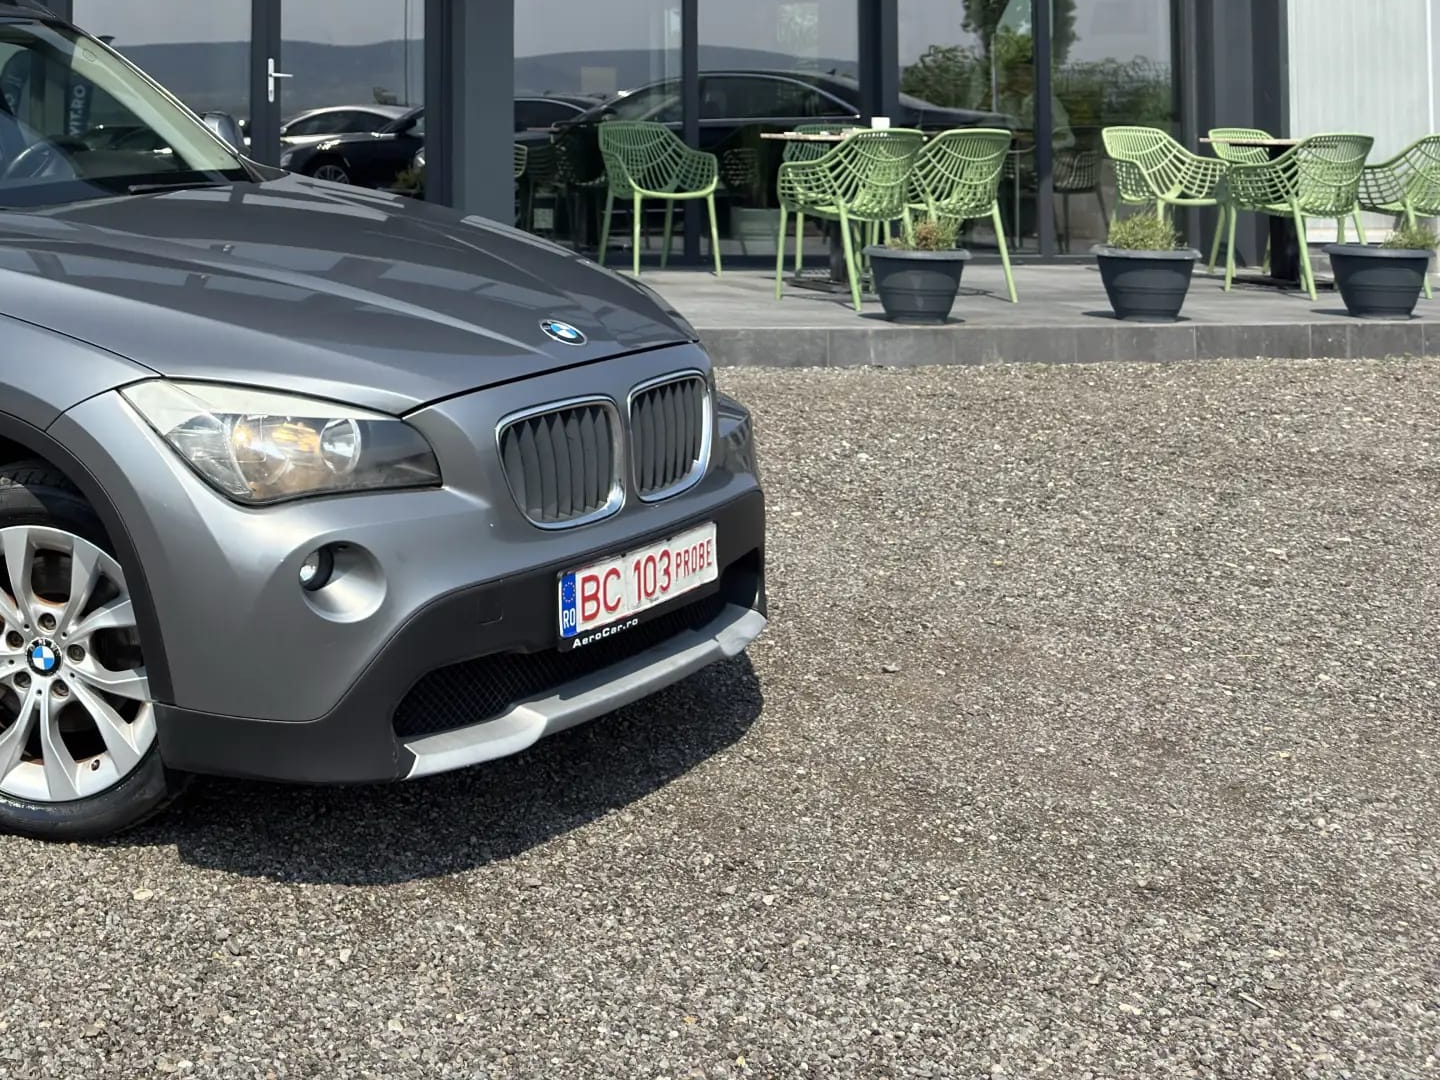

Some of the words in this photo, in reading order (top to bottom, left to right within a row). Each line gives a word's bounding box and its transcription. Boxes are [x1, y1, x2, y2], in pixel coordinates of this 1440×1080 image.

[69, 84, 87, 138] VIT.RO
[580, 567, 621, 623] BC
[633, 549, 671, 602] 103
[675, 538, 712, 580] PROBE
[563, 607, 576, 629] RO
[572, 618, 639, 649] AeroCar.ro
